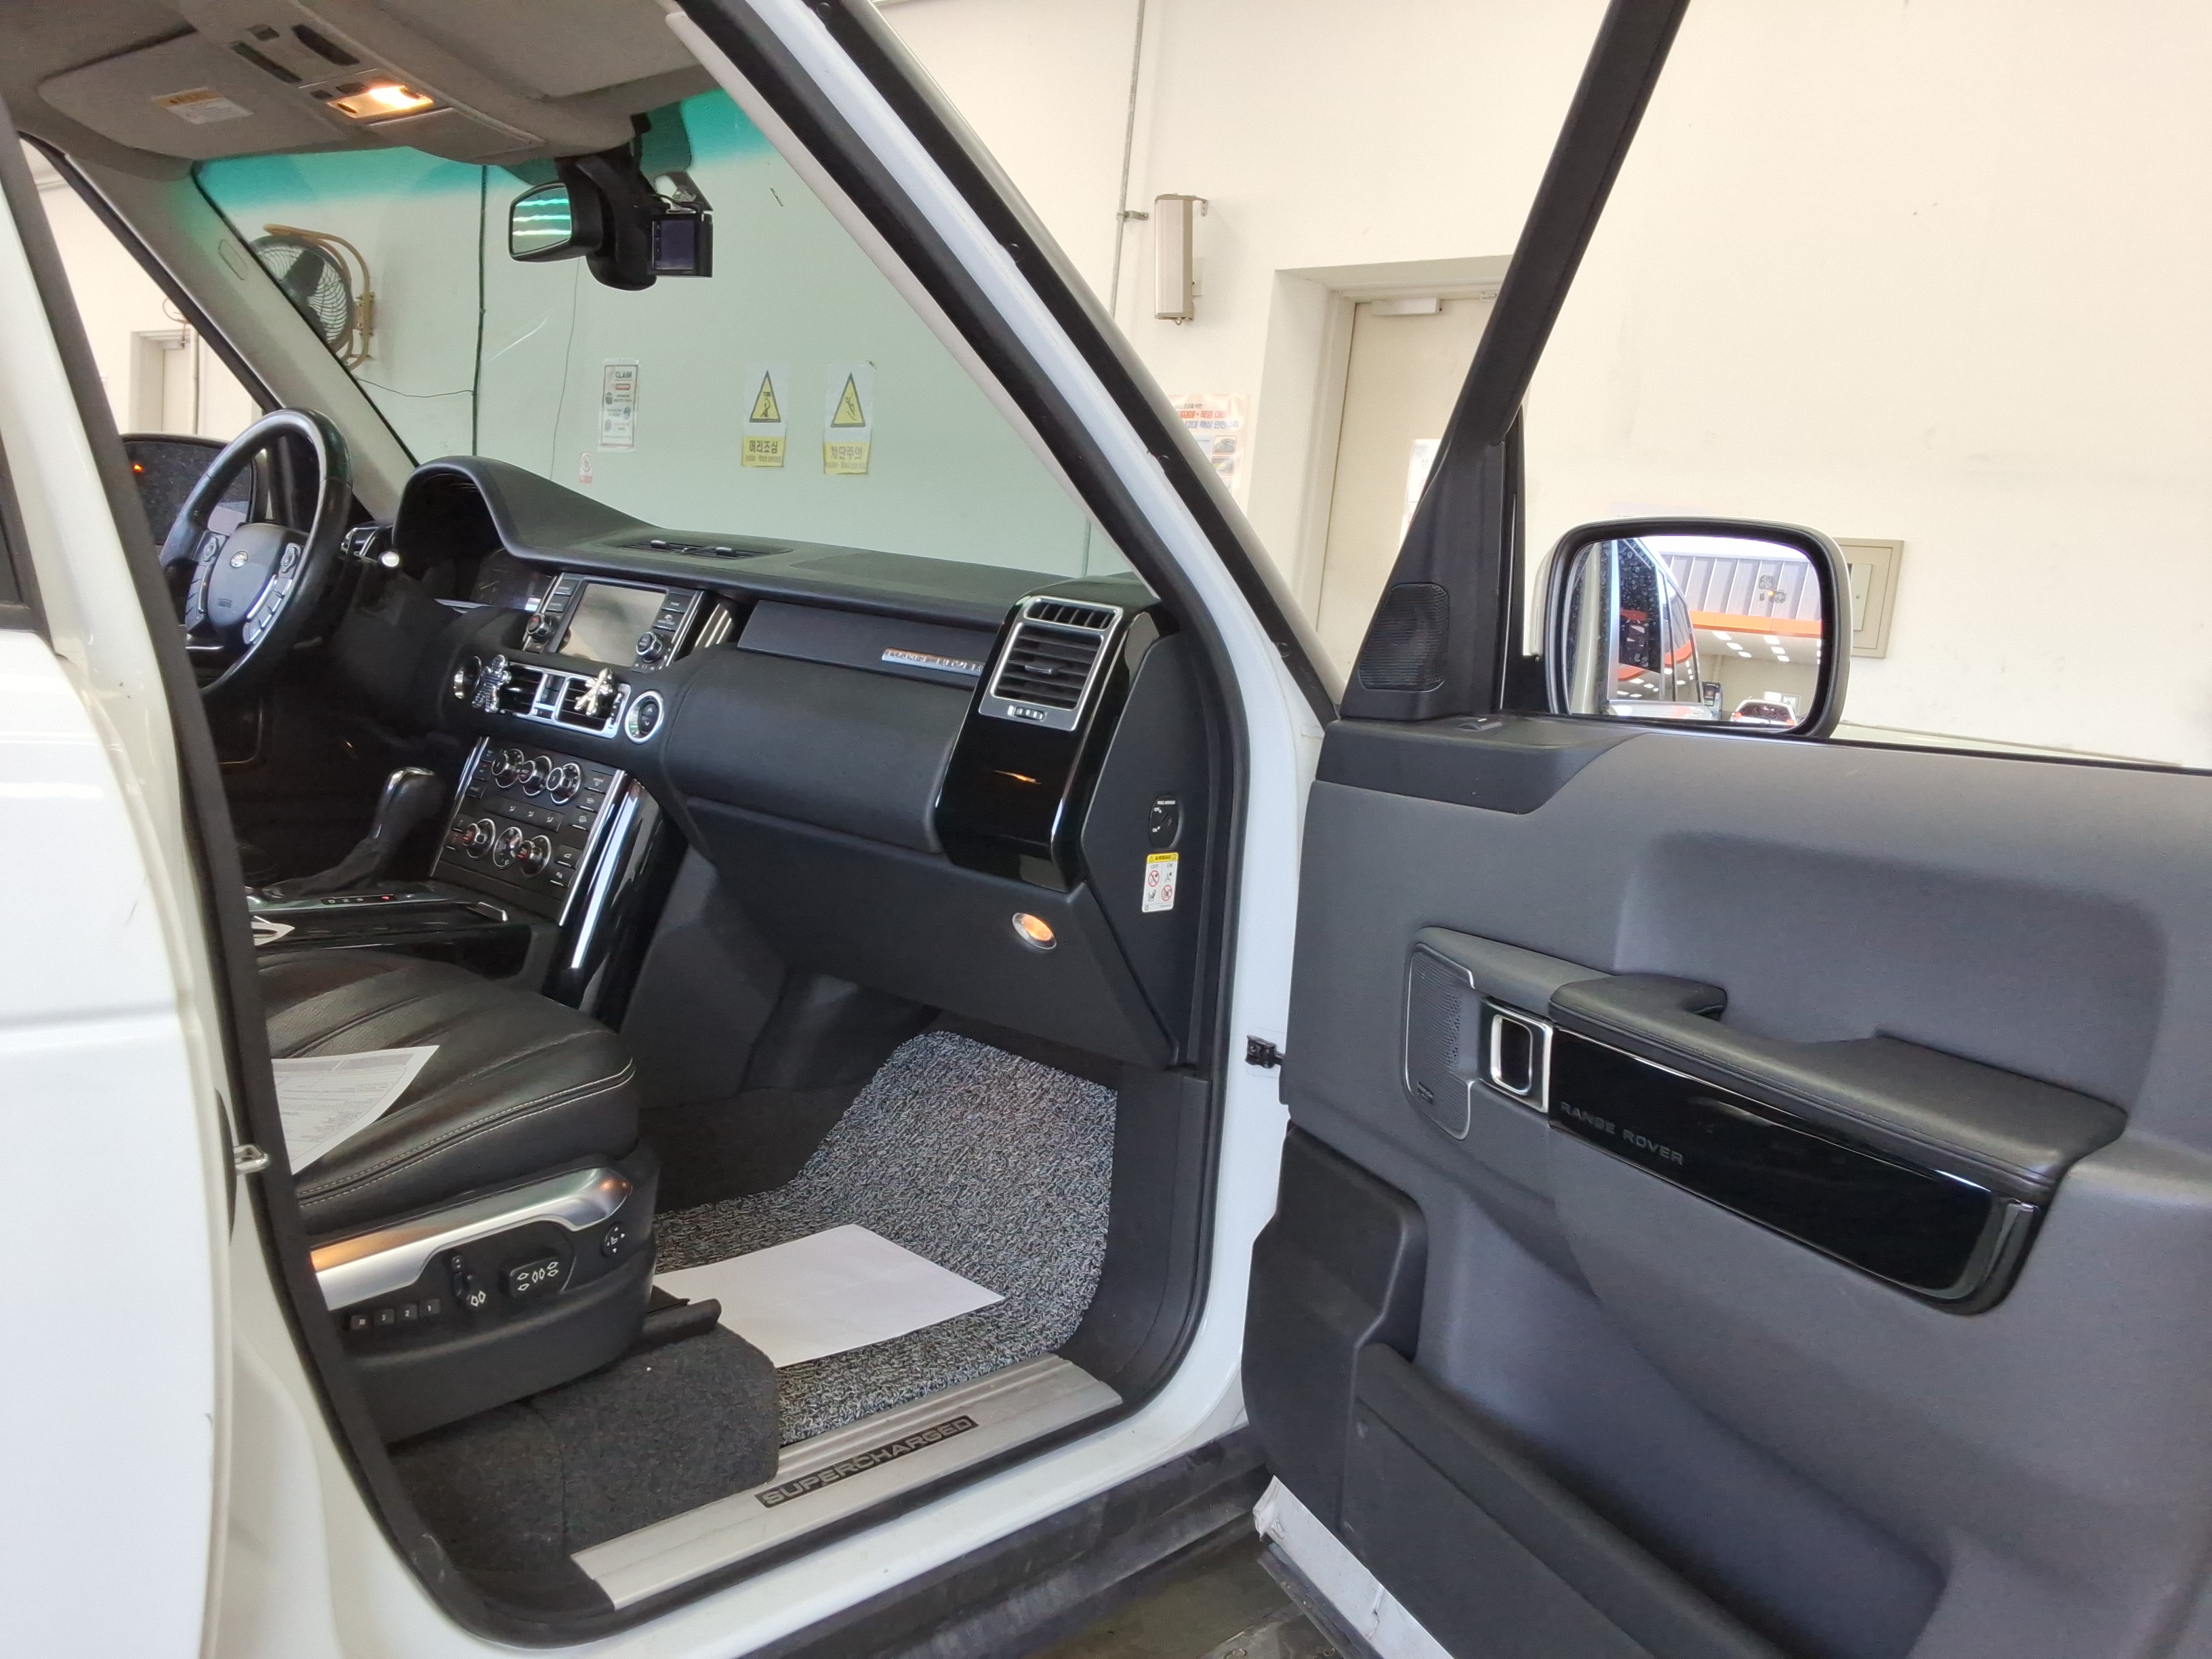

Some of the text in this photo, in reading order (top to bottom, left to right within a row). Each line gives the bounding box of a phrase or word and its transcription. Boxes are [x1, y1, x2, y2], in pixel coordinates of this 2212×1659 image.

[1561, 1101, 1683, 1166] RANGE ROVER
[762, 1418, 973, 1504] SUPERCHARGED
